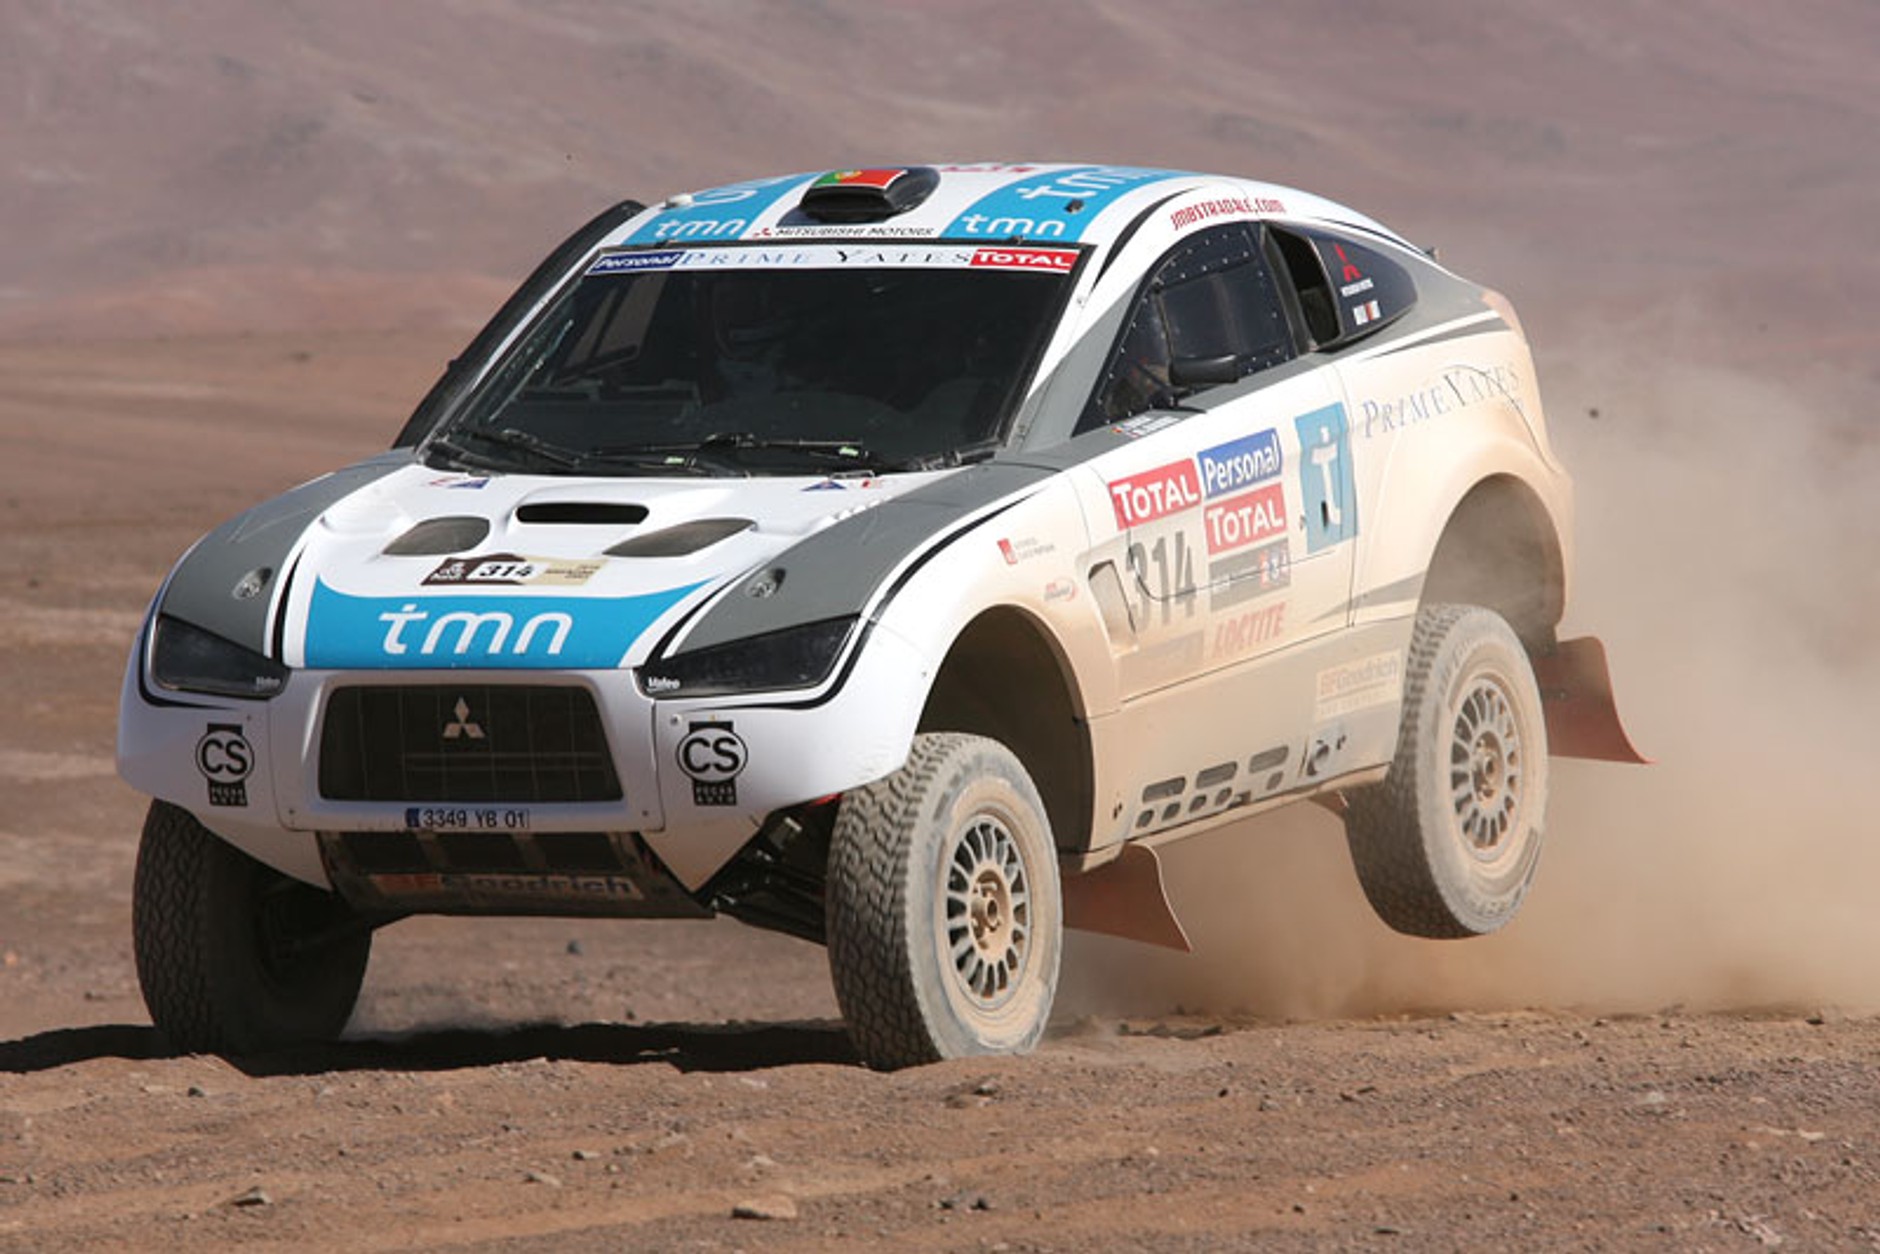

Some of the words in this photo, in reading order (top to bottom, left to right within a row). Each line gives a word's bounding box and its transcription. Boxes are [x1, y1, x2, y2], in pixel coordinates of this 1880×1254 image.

[654, 219, 748, 238] tmn
[961, 213, 1064, 237] tmn
[682, 252, 812, 266] PRIME
[836, 251, 971, 265] YATES
[975, 251, 1073, 269] TOTAL
[1203, 431, 1281, 492] Personal
[1112, 476, 1199, 524] TOTAL
[1207, 496, 1286, 546] TOTAL
[479, 564, 535, 577] 314
[1125, 530, 1198, 634] 314
[378, 603, 573, 656] tmn
[1212, 602, 1288, 660] LOCTITE
[202, 738, 248, 775] CS
[683, 737, 740, 774] CS
[423, 810, 467, 828] 3349
[475, 810, 498, 828] YB
[505, 811, 527, 828] 01
